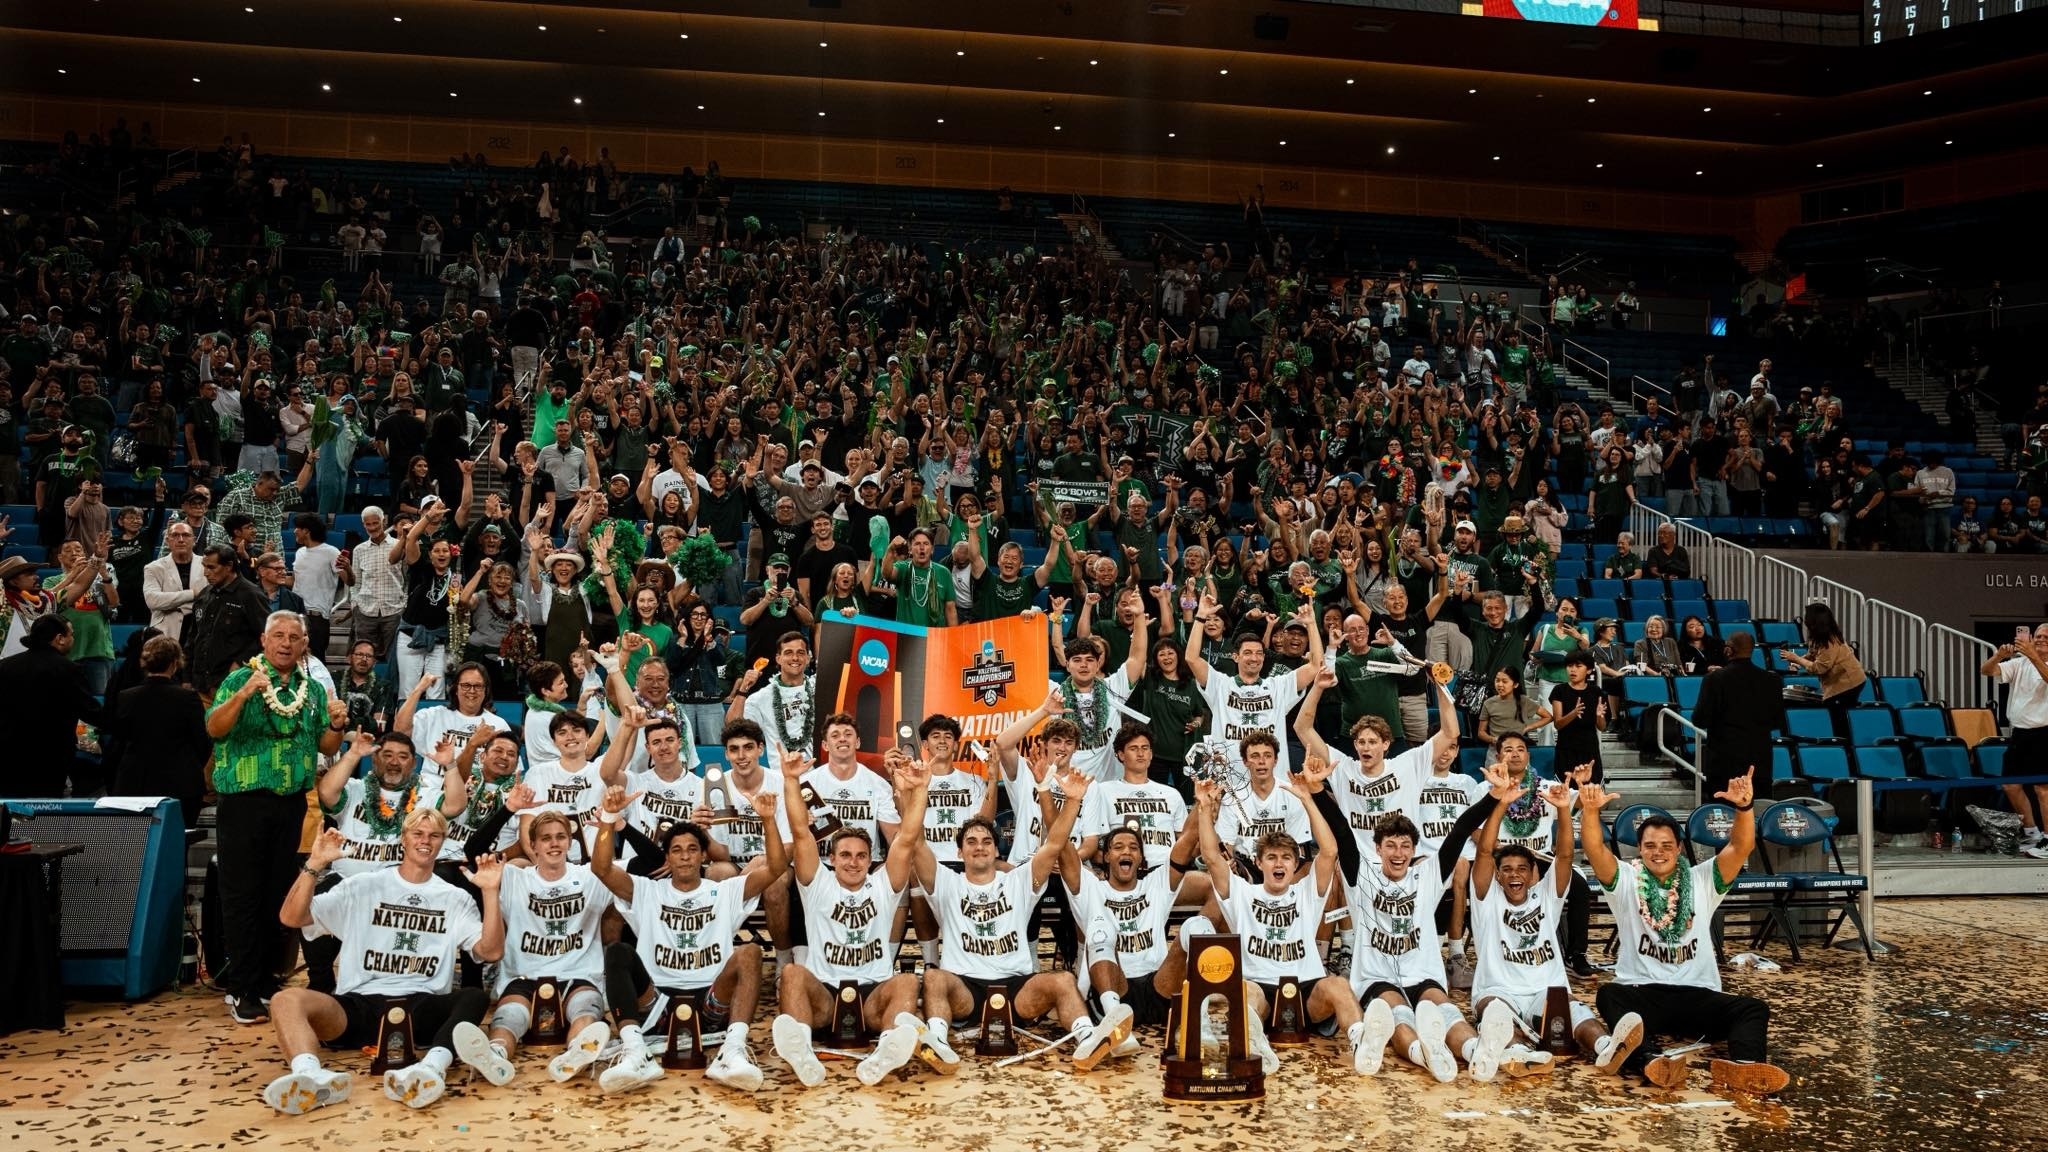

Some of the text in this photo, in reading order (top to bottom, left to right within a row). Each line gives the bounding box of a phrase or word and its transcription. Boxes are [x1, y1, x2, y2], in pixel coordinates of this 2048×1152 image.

[1874, 13, 1881, 26] 7
[1905, 6, 1917, 20] 15
[1874, 31, 1881, 44] 9
[1908, 23, 1915, 37] 7
[1942, 16, 1950, 29] 0
[1979, 8, 1984, 21] 1
[1054, 487, 1067, 496] GO
[1985, 574, 2024, 588] UCLA
[861, 655, 888, 669] NCAA
[966, 670, 1012, 685] CHAMPIONSHIP
[927, 794, 972, 808] ATIONAL
[1419, 790, 1471, 807] NATIONAL
[1113, 802, 1171, 815] NATIONAL
[1738, 881, 1765, 889] CHAMPIONS
[1373, 892, 1416, 916] NATION
[371, 908, 447, 933] NATIONAL
[654, 942, 722, 971] CHAMPIONS
[823, 937, 884, 967] CHAMPIONS
[1248, 934, 1306, 963] CHAMPIONS
[363, 949, 440, 978] CHAMPIONS
[1189, 1084, 1247, 1093] NATIONAL CHAMPION
